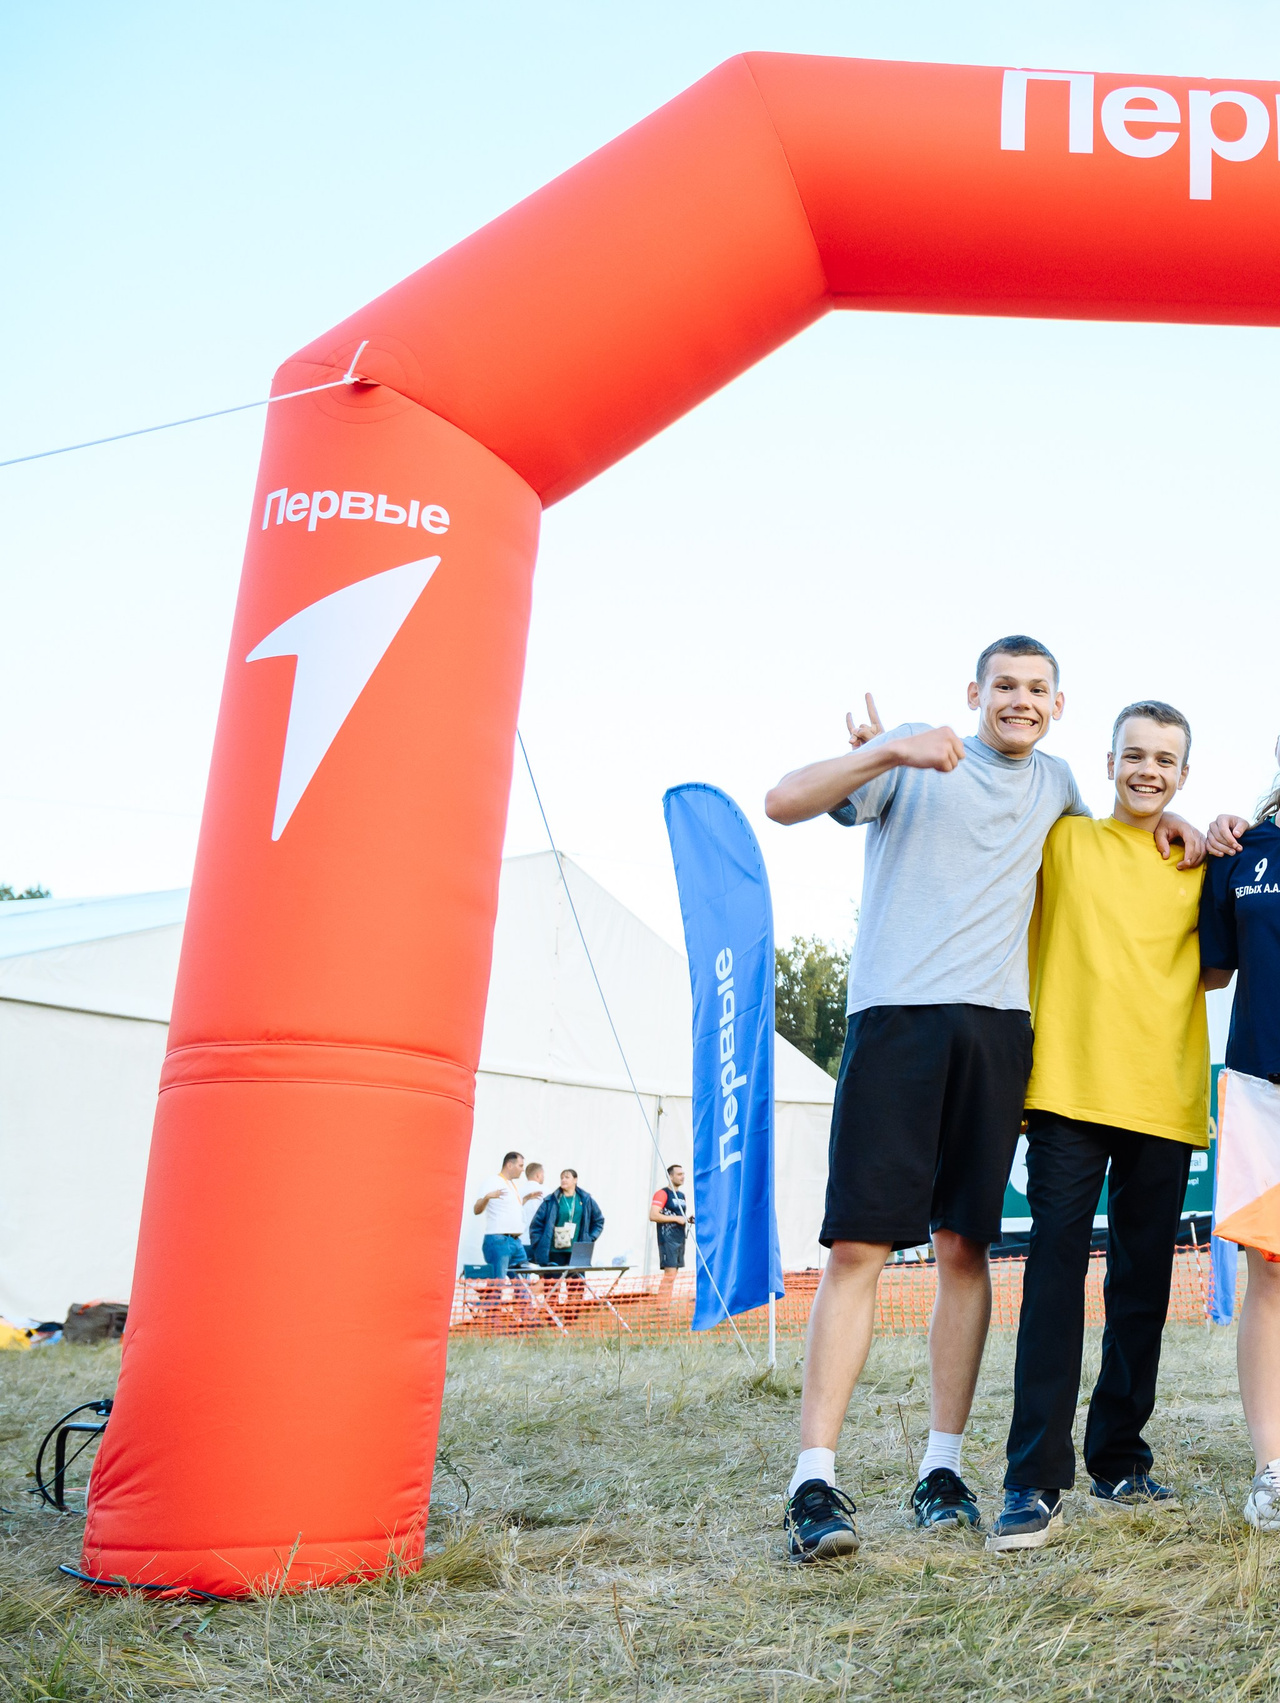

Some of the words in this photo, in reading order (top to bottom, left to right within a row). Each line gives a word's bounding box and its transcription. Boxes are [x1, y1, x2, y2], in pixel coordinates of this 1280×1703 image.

[262, 487, 451, 535] Первые
[1254, 857, 1268, 882] 9
[1235, 884, 1262, 899] БЕЛЫХ
[715, 947, 748, 1174] Первые
